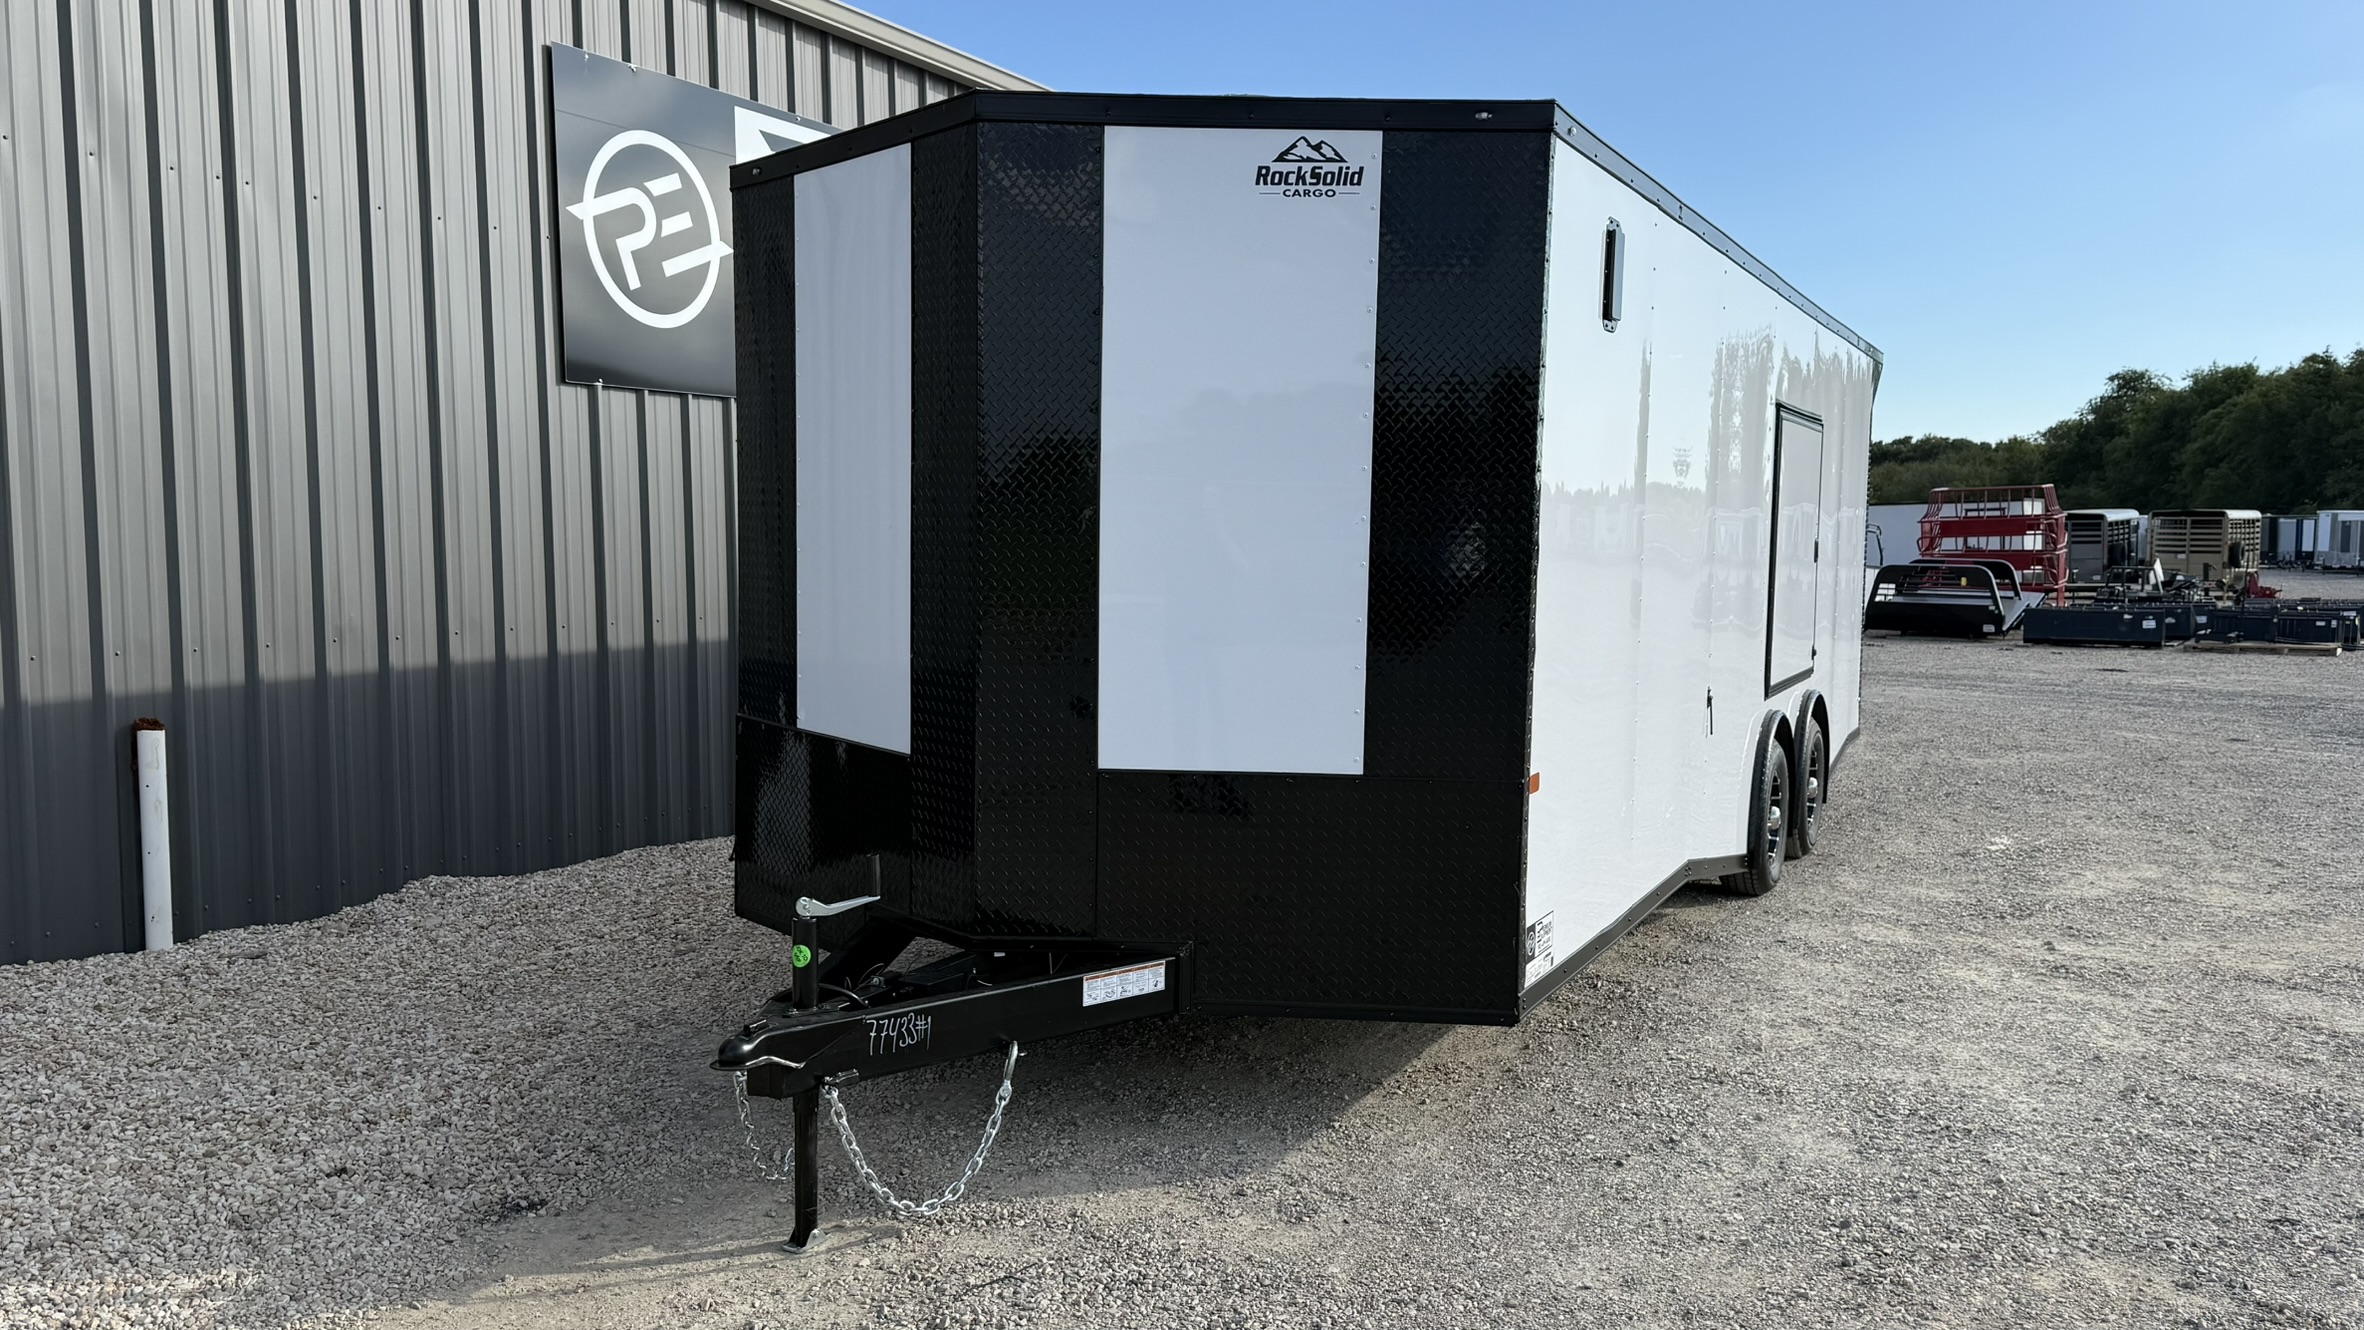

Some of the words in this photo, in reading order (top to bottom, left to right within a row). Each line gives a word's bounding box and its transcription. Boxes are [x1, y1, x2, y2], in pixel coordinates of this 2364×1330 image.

[1255, 165, 1365, 187] RockSolid
[1282, 188, 1336, 198] CARGO
[866, 1012, 932, 1056] 77433#1
